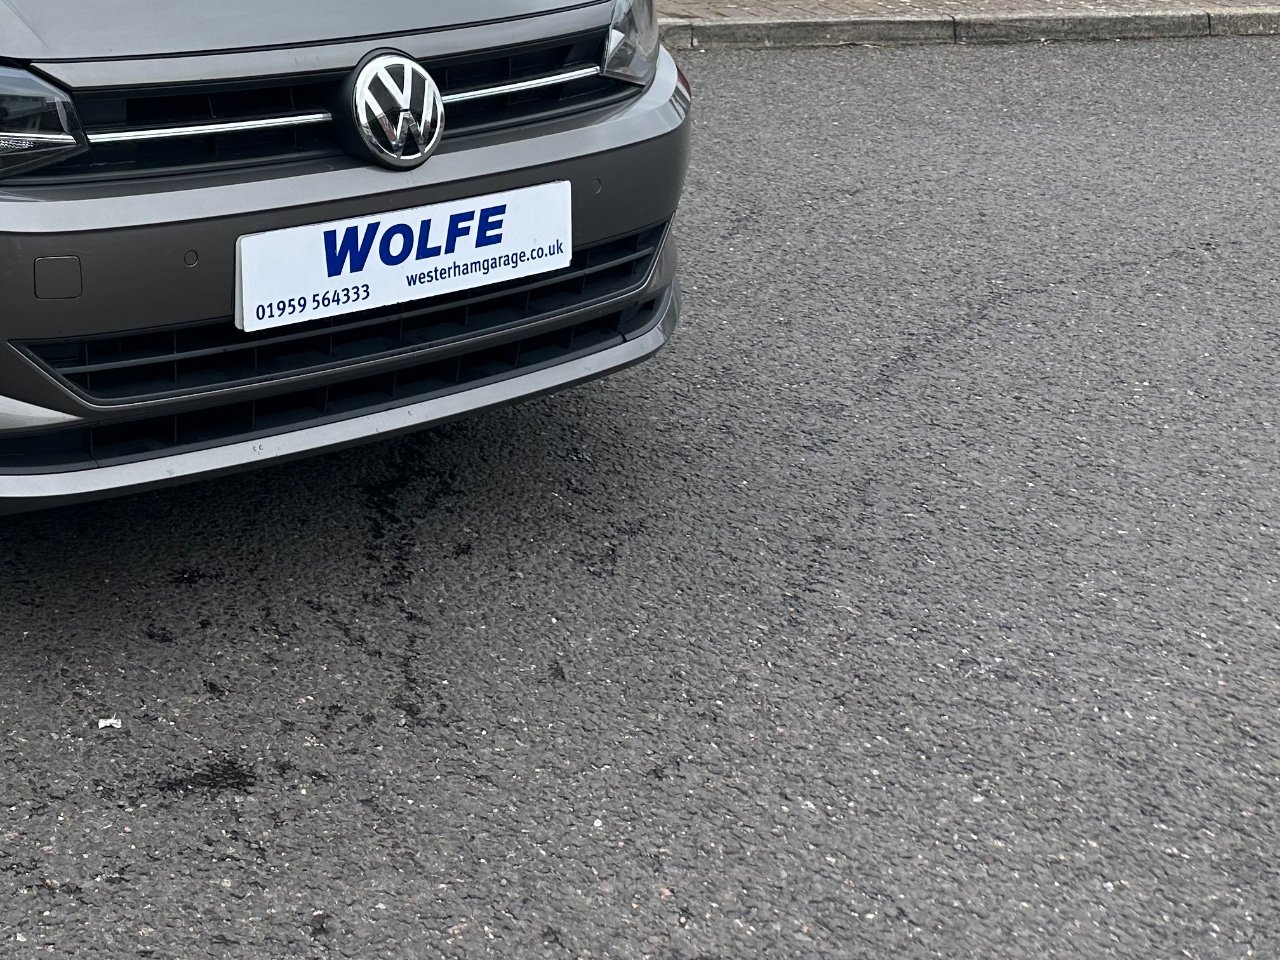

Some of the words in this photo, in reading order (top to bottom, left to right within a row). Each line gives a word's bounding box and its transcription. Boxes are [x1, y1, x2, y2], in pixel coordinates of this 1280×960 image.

[323, 204, 507, 278] WOLFE
[406, 239, 564, 287] westerhamgarage.co.uk
[255, 296, 307, 321] 01959
[312, 284, 371, 310] 564333
